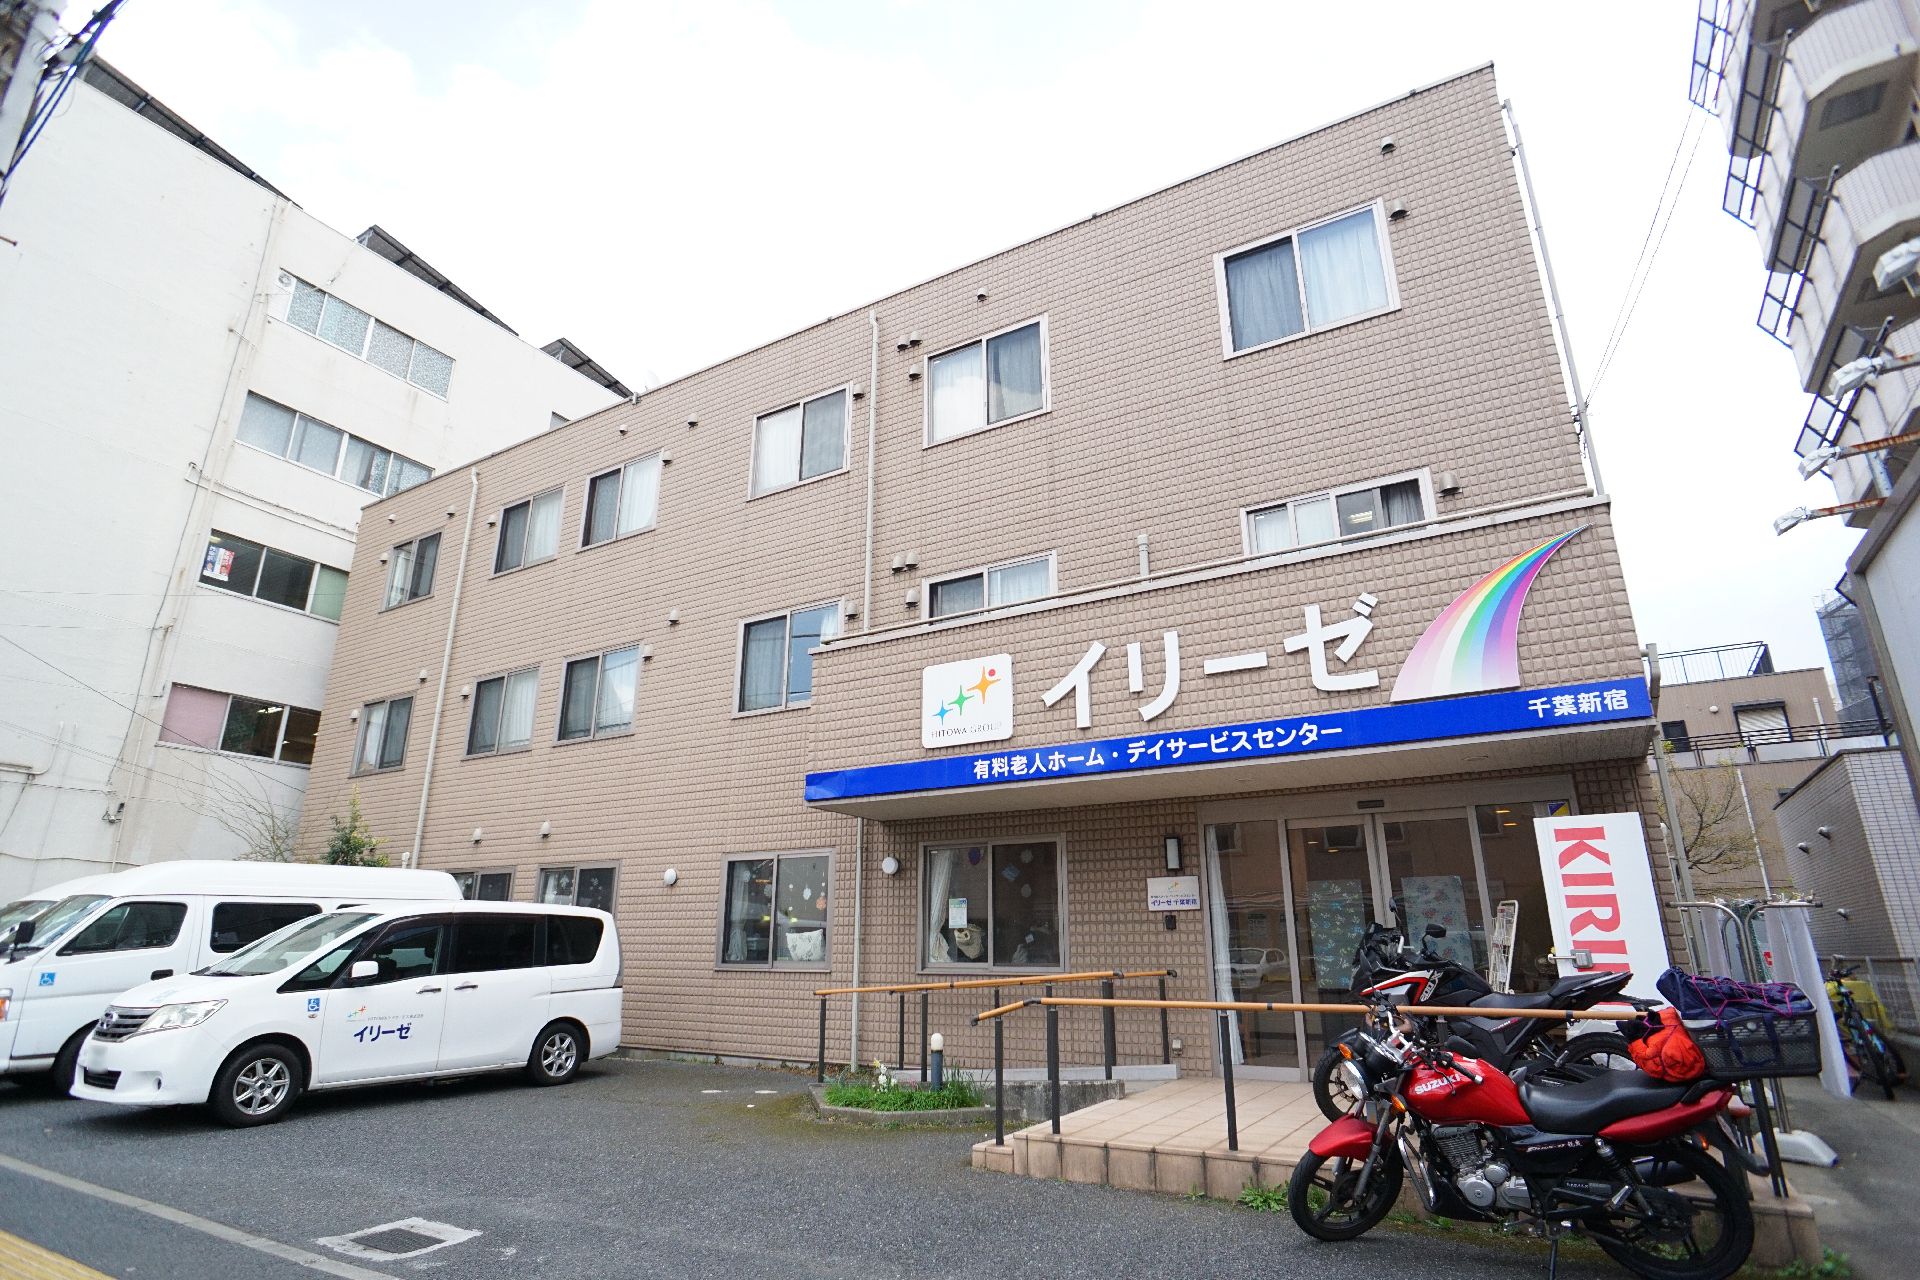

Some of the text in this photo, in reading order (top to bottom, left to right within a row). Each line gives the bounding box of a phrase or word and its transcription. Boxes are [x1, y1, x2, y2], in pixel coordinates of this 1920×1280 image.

[1041, 592, 1380, 729] イリーゼ
[1528, 689, 1629, 718] 千葉新宿
[931, 727, 967, 739] HITOWA
[973, 724, 1343, 780] 有料老人ホーム・デイサービスセンター
[1554, 826, 1632, 1007] KIRI
[353, 1022, 412, 1042] イリーゼ
[1415, 1073, 1461, 1095] SUZUKI
